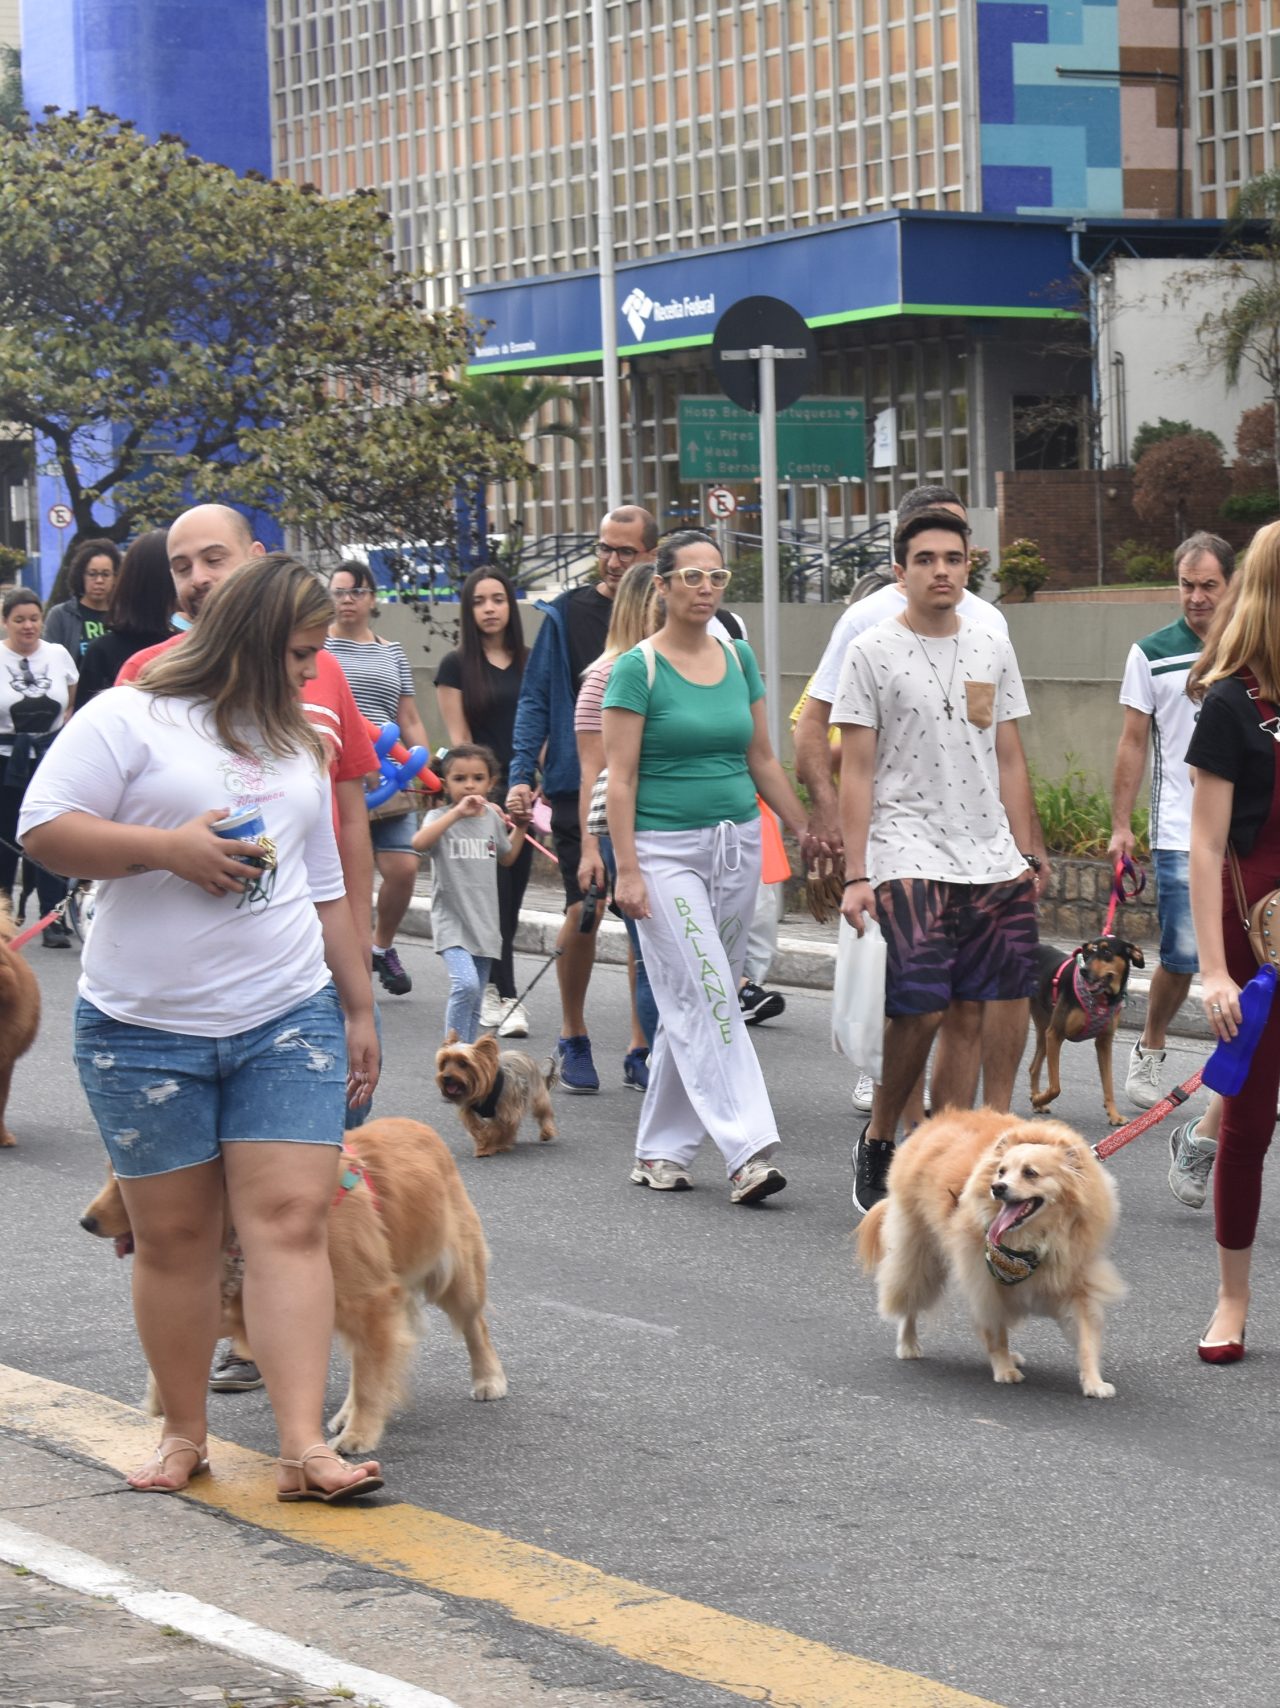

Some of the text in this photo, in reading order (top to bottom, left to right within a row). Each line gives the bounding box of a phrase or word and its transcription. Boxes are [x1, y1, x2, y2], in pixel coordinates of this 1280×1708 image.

[653, 293, 715, 322] Receita Federal
[684, 406, 718, 418] Hosp.
[704, 429, 754, 441] V. Pires
[788, 462, 831, 473] Centro
[674, 897, 733, 1045] BALANCE
